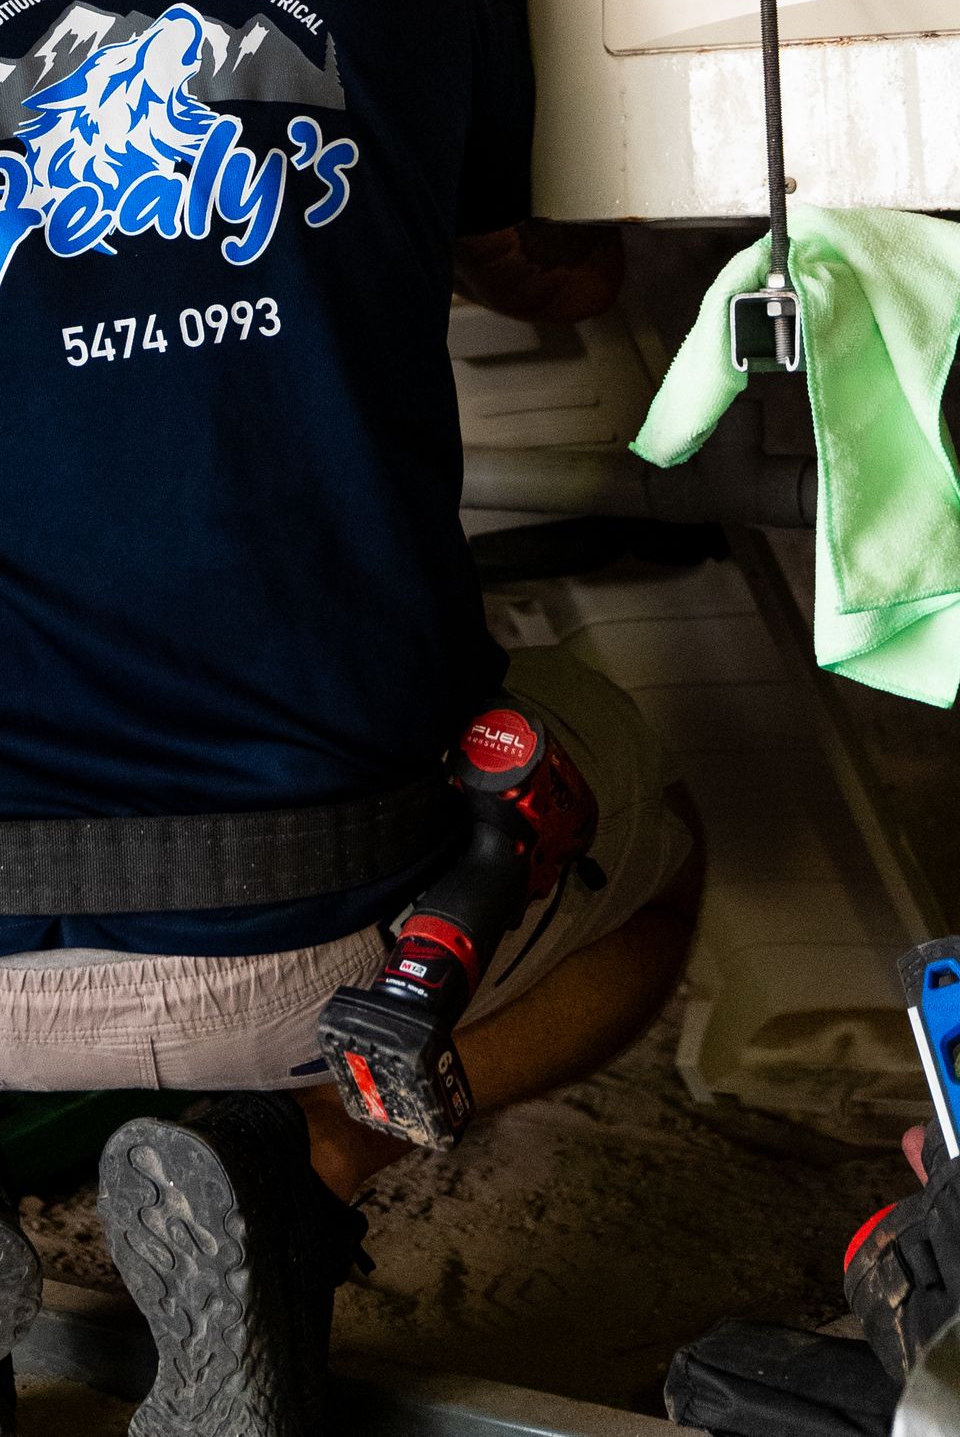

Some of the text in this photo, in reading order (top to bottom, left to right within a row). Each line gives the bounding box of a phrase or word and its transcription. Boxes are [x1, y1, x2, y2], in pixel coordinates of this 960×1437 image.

[61, 297, 282, 367] 5474 0993
[472, 724, 525, 749] FUEL
[400, 961, 425, 975] M12
